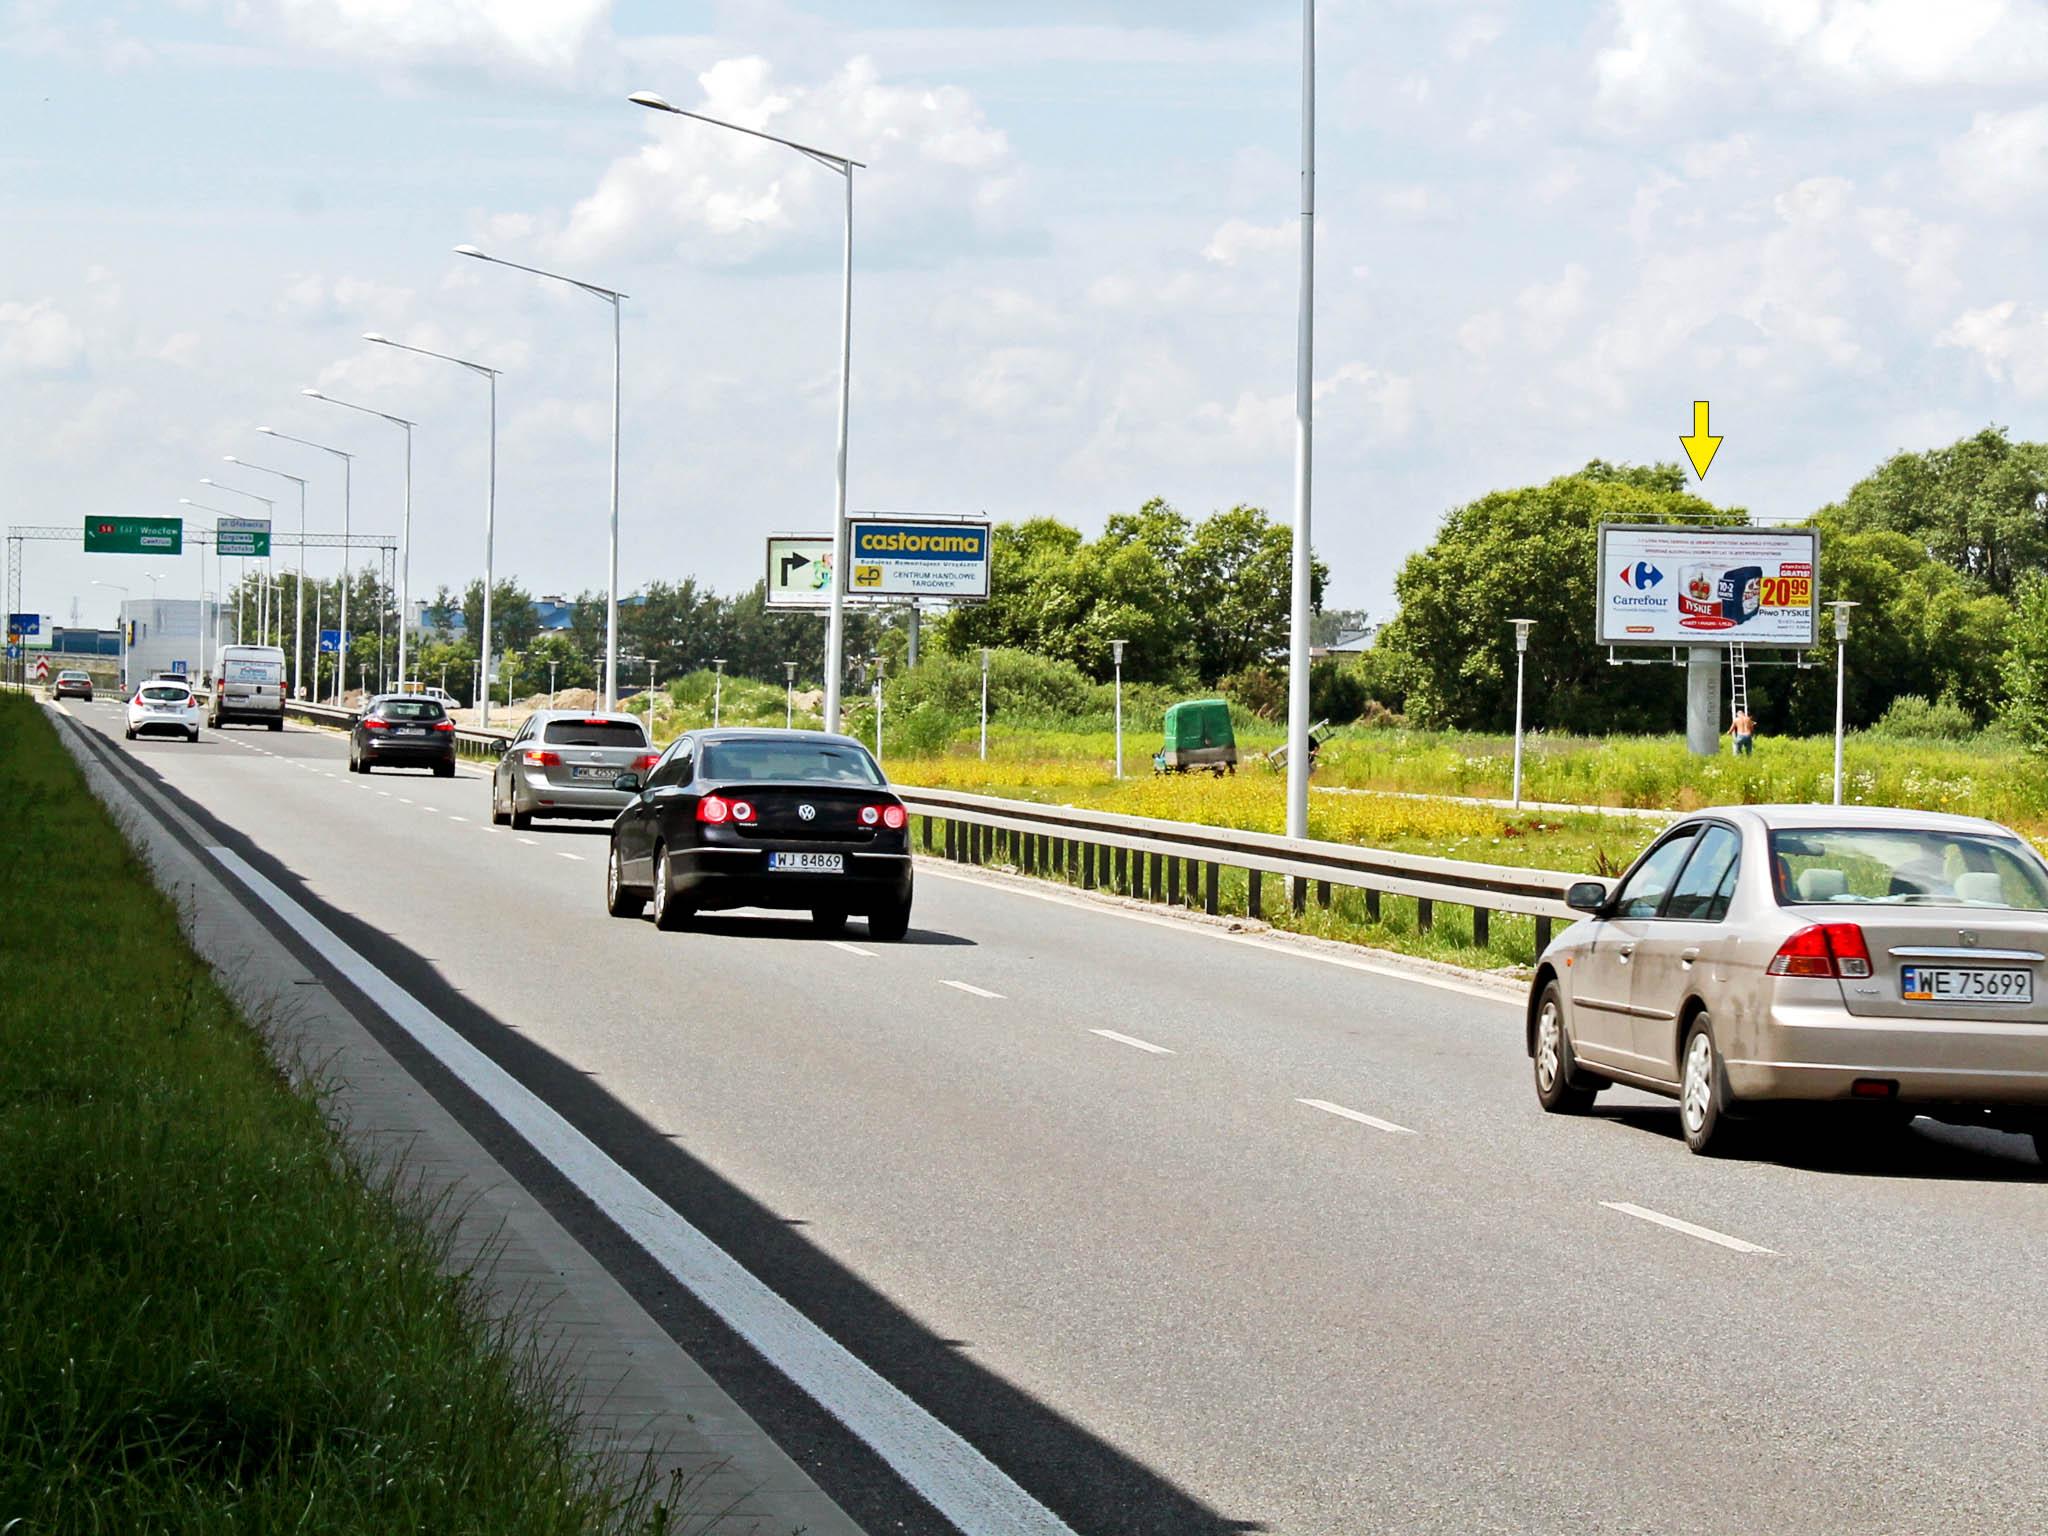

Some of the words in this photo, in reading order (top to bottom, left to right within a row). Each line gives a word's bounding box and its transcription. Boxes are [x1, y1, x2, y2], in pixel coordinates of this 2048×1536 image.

[861, 532, 979, 553] castorama
[893, 571, 930, 579] CENTRUM
[933, 572, 976, 581] HANDLOWE
[1762, 579, 1790, 606] 20
[1791, 579, 1808, 595] 99
[1613, 594, 1668, 606] Carrefour
[1685, 599, 1712, 615] TYSKIE
[1759, 609, 1779, 617] Piwo
[1781, 609, 1810, 617] TYSKIE
[777, 854, 796, 866] WJ
[801, 855, 841, 867] 84869
[1919, 971, 1951, 993] WE
[1959, 972, 2026, 995] 75699
